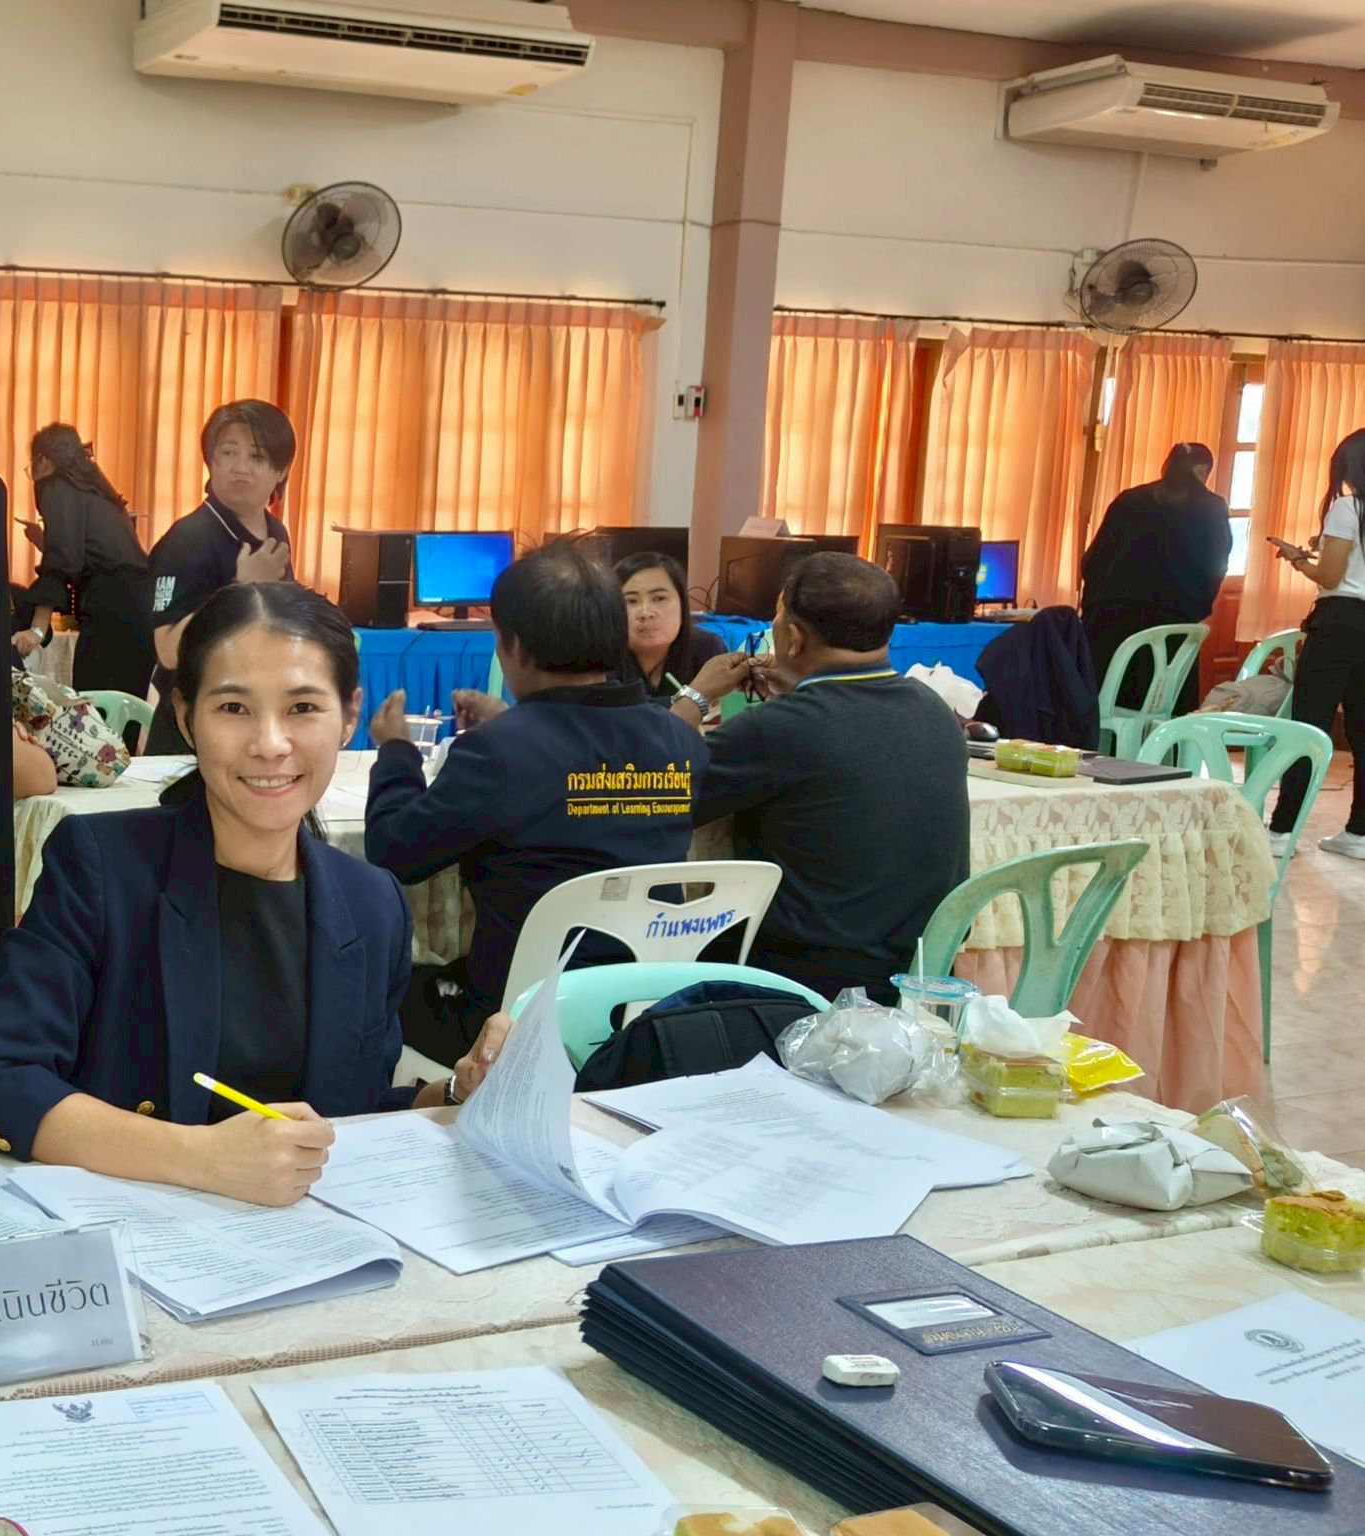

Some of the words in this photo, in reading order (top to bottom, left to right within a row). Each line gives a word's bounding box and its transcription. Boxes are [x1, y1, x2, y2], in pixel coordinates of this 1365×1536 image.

[567, 803, 610, 818] Department
[612, 802, 620, 814] of
[621, 801, 651, 817] Learning
